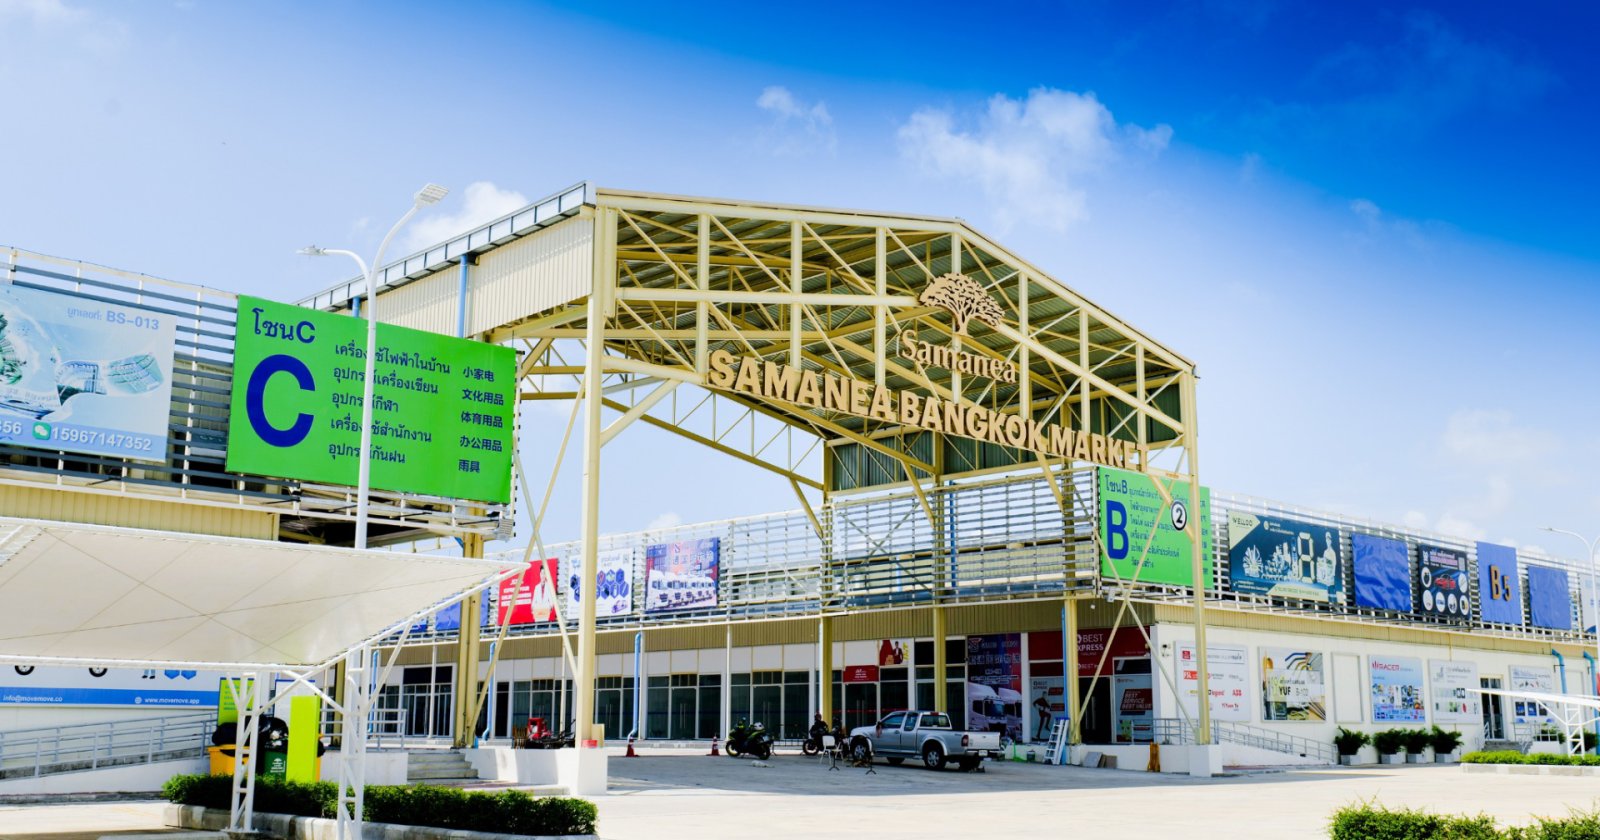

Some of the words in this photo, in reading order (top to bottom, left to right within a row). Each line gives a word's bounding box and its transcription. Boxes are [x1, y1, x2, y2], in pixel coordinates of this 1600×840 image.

[106, 310, 159, 331] BS-013
[898, 329, 1016, 384] Samanea
[463, 366, 495, 382] 小家电
[246, 354, 316, 448] C
[462, 388, 504, 406] 文化用品
[461, 410, 503, 428] 体育用品
[708, 349, 897, 423] SAMANEA
[900, 388, 1046, 452] BANGKOK
[1049, 424, 1149, 473] MARKET
[52, 427, 152, 451] 15967147352
[460, 435, 503, 452] 办公用品
[458, 459, 480, 473] 雨具
[1175, 507, 1183, 524] 2
[1106, 499, 1129, 560] B
[1083, 633, 1104, 643] BEST
[1077, 644, 1104, 652] XPRESS
